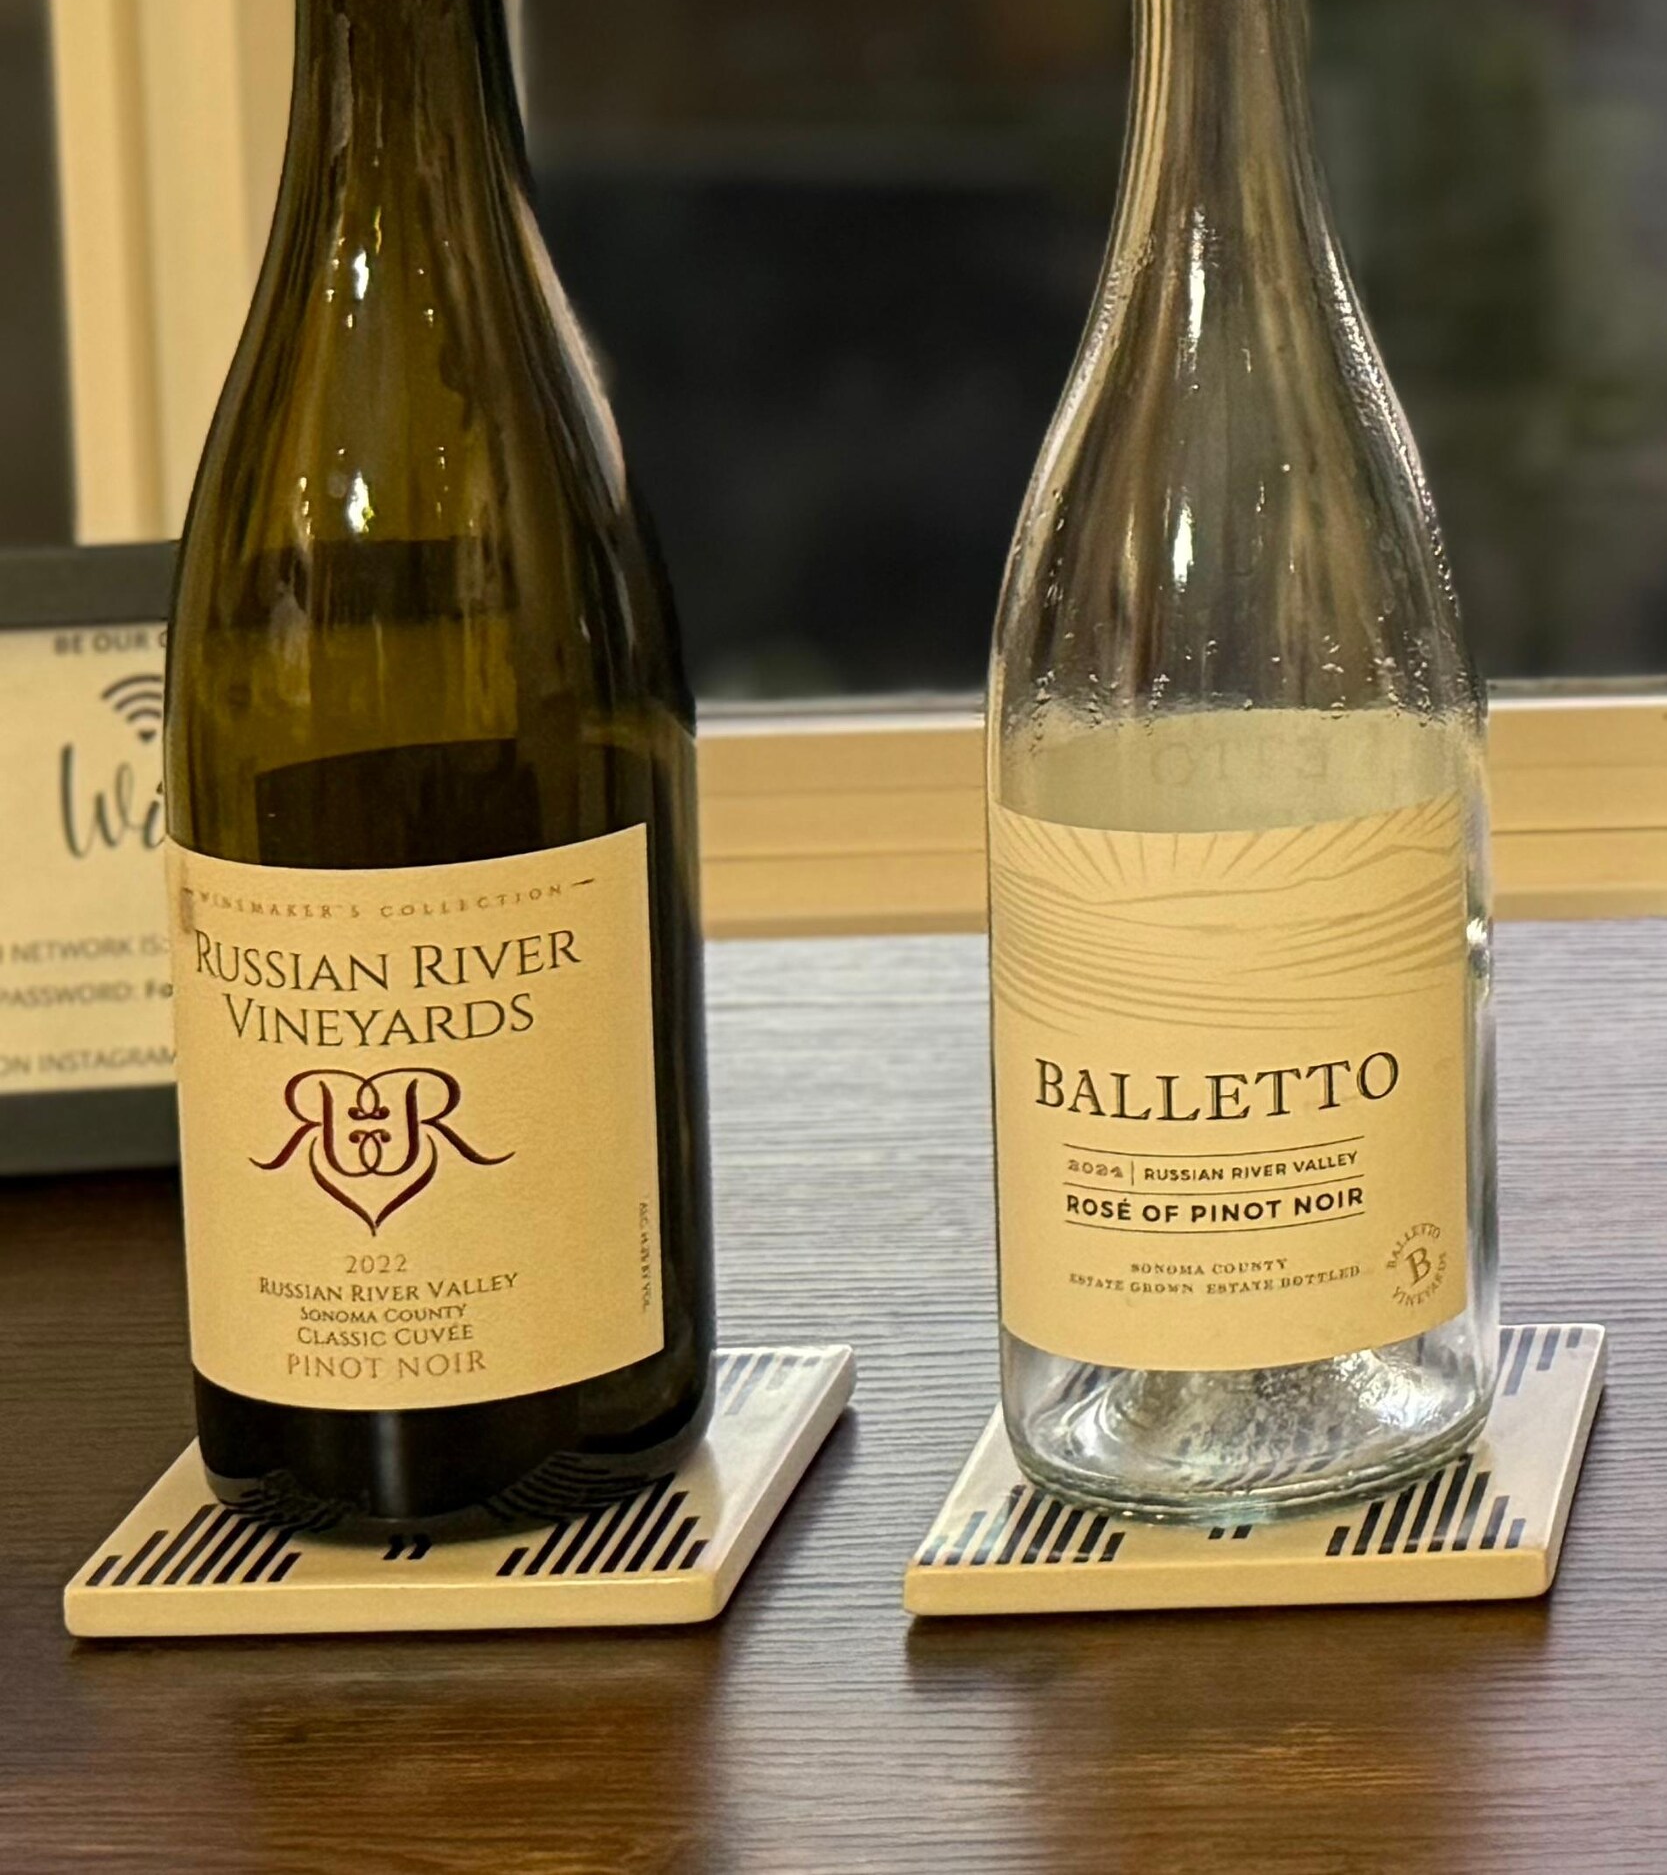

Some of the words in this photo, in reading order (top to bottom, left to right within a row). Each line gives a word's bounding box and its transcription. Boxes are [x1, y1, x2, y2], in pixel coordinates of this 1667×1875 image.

[54, 635, 83, 655] BE
[92, 631, 149, 654] OUR
[379, 884, 562, 919] COLLECTION
[12, 938, 131, 965] NETWORK
[196, 930, 389, 992] RUSSIAN
[411, 929, 582, 990] RIVER
[222, 992, 535, 1047] VINEYARDS
[1033, 1051, 1400, 1122] BALLETTO
[1067, 1158, 1125, 1178] 2024
[1143, 1167, 1224, 1182] RUSSIAN
[1231, 1162, 1287, 1180] RIVER
[1292, 1150, 1358, 1173] VALLEY
[1066, 1194, 1132, 1221] ROSÉ
[1142, 1204, 1180, 1223] OF
[1190, 1199, 1282, 1223] PINOT
[1293, 1187, 1364, 1217] NOIR
[345, 1254, 408, 1275] 2022
[1068, 1272, 1125, 1292] ESTATE
[1129, 1281, 1194, 1295] GROWN
[1206, 1278, 1275, 1295] ESTATE
[1280, 1264, 1361, 1289] BOTTLED
[1130, 1262, 1206, 1276] SONOMA
[1212, 1257, 1288, 1275] COUNTY
[1404, 1246, 1432, 1287] B
[259, 1276, 343, 1302] RUSSIAN
[351, 1283, 420, 1303] RIVER
[428, 1272, 519, 1298] VALLEY
[300, 1306, 378, 1324] SONOMA
[384, 1303, 468, 1322] COUNTY
[297, 1326, 387, 1347] CLASSIC
[287, 1352, 384, 1380] PINOT
[397, 1349, 487, 1379] NOIR
